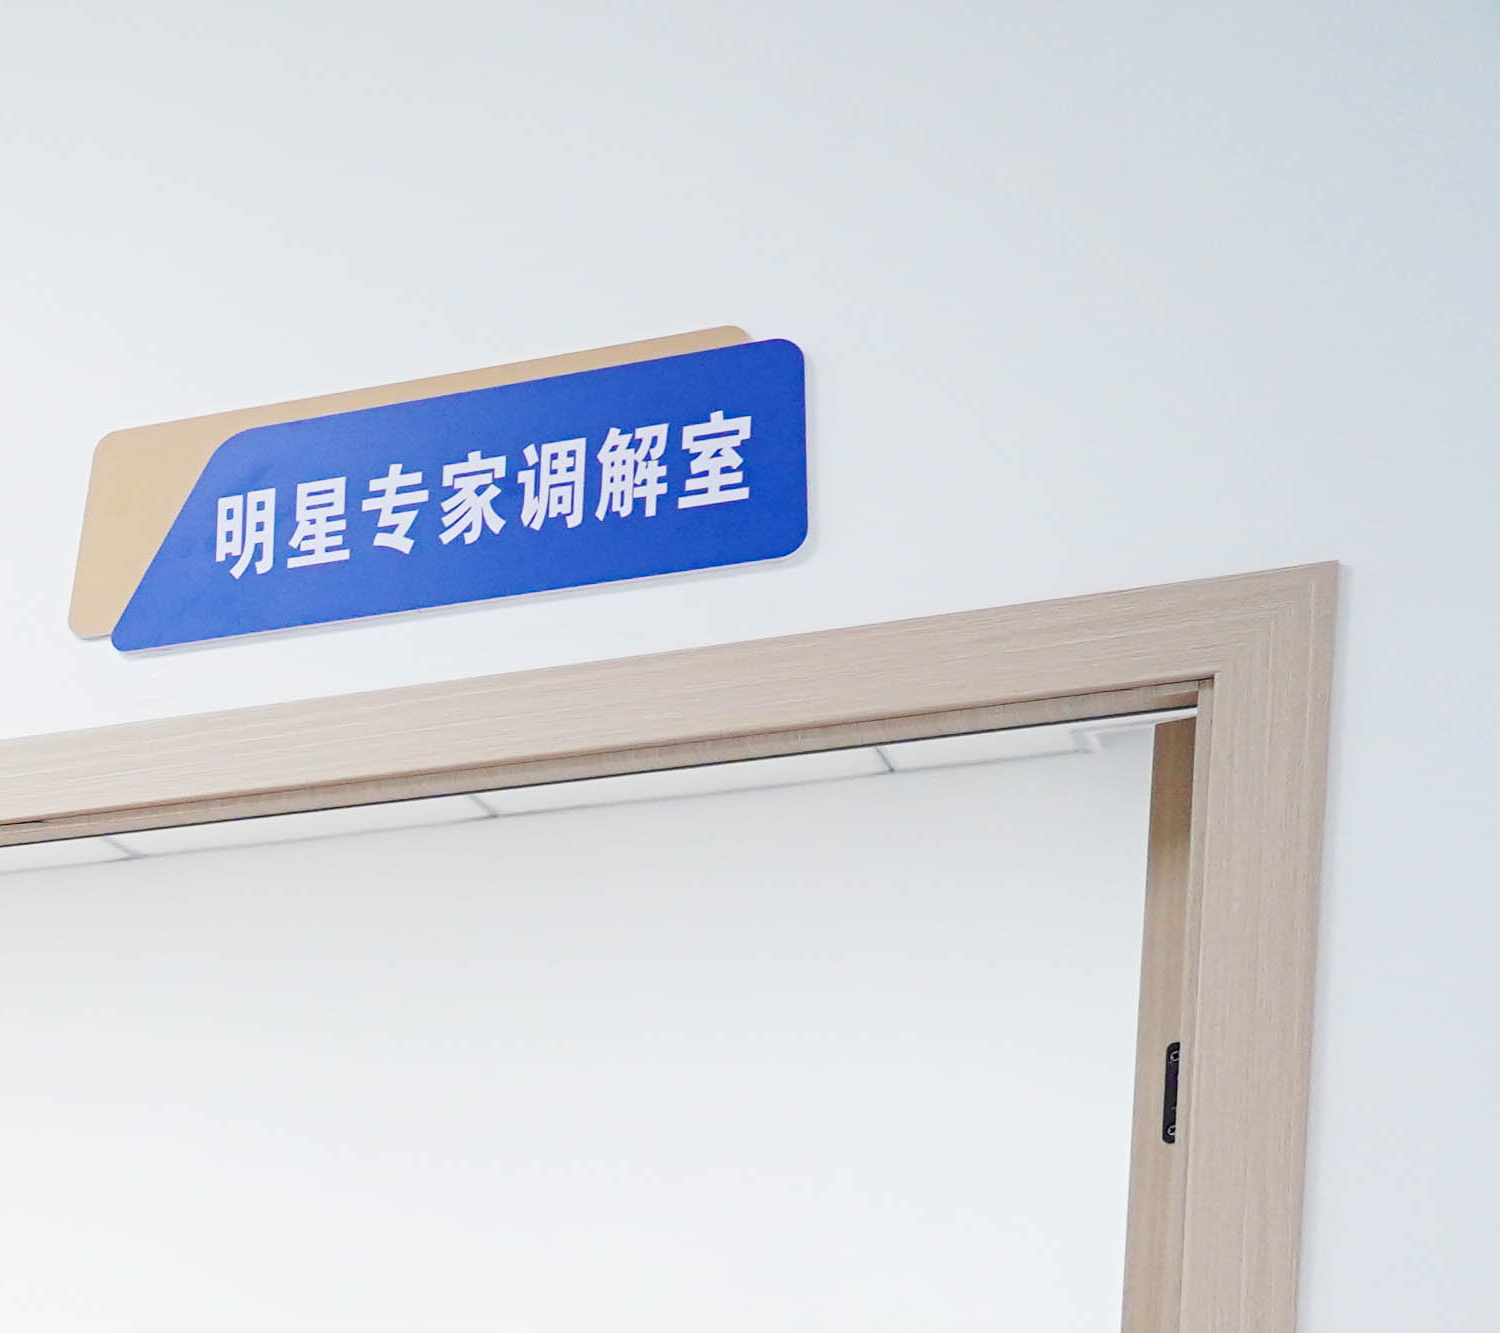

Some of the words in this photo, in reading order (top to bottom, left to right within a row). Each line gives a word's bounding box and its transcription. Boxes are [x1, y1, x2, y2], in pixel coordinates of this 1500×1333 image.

[214, 410, 753, 579] 明星专家调解室
